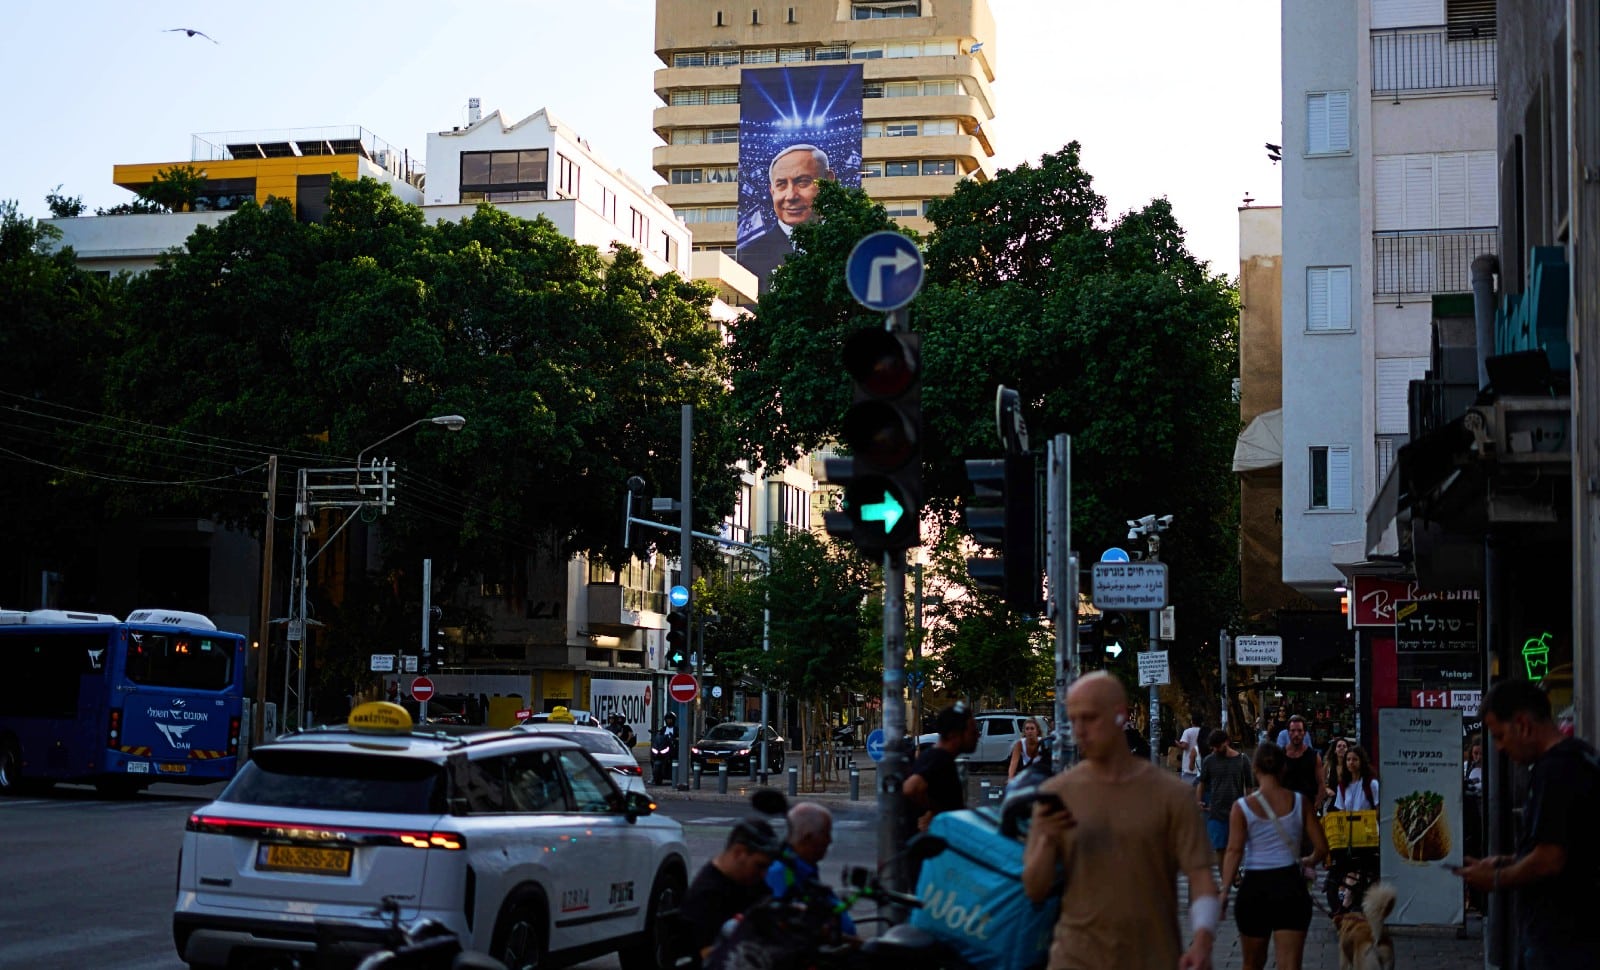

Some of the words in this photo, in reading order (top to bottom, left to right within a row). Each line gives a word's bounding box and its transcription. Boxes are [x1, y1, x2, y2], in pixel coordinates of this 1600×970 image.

[1096, 567, 1125, 577] בוגרשוב
[1362, 589, 1397, 619] Ra
[1440, 670, 1472, 680] Vintage
[1416, 691, 1447, 708] 1+1
[147, 706, 169, 718] חשמלי
[183, 711, 209, 721] אוטובוס
[594, 695, 620, 726] VERY
[621, 695, 646, 725] SOON
[176, 742, 191, 750] DAN
[922, 882, 990, 941] Wolt
